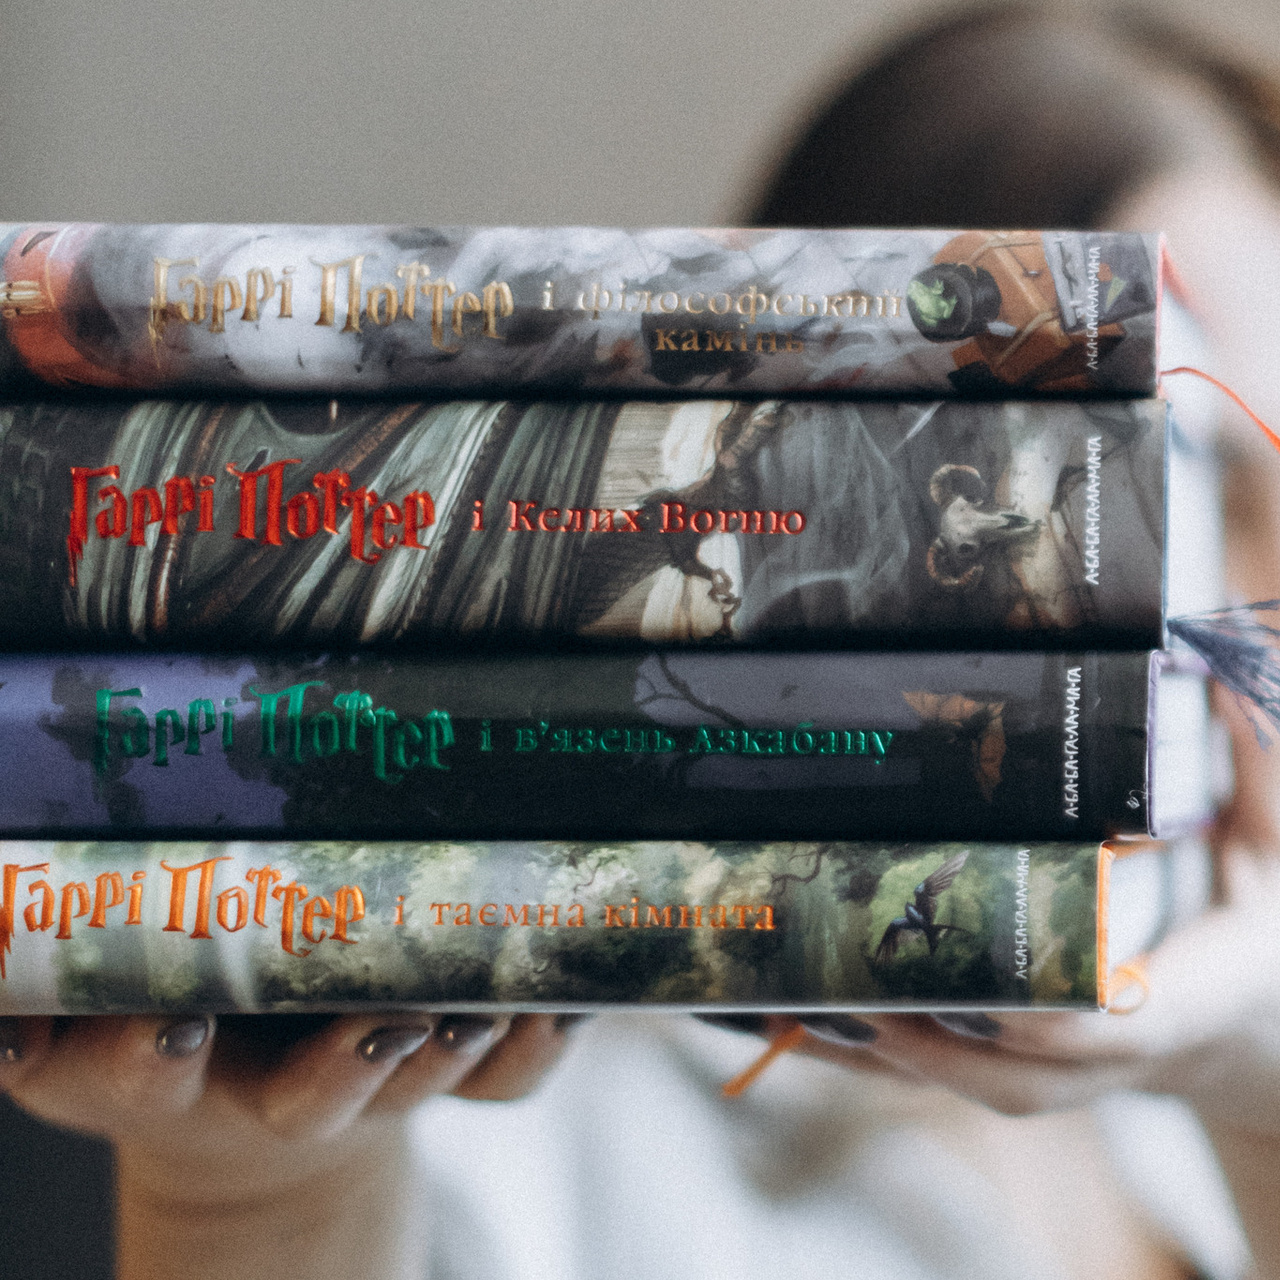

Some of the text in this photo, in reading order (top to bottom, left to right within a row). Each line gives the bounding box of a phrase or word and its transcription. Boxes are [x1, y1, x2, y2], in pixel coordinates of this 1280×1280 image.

[149, 254, 904, 370] Гаррі Поттер і філософський
[654, 321, 805, 353] камінь
[66, 458, 807, 588] Гаррі Поттер і Келих Вогню
[94, 686, 240, 776] Гаррі
[249, 680, 456, 784] Поттер
[479, 721, 493, 753] і
[690, 722, 894, 765] Азкабану
[0, 856, 777, 980] Гаррі Поттер і таємна кімната
